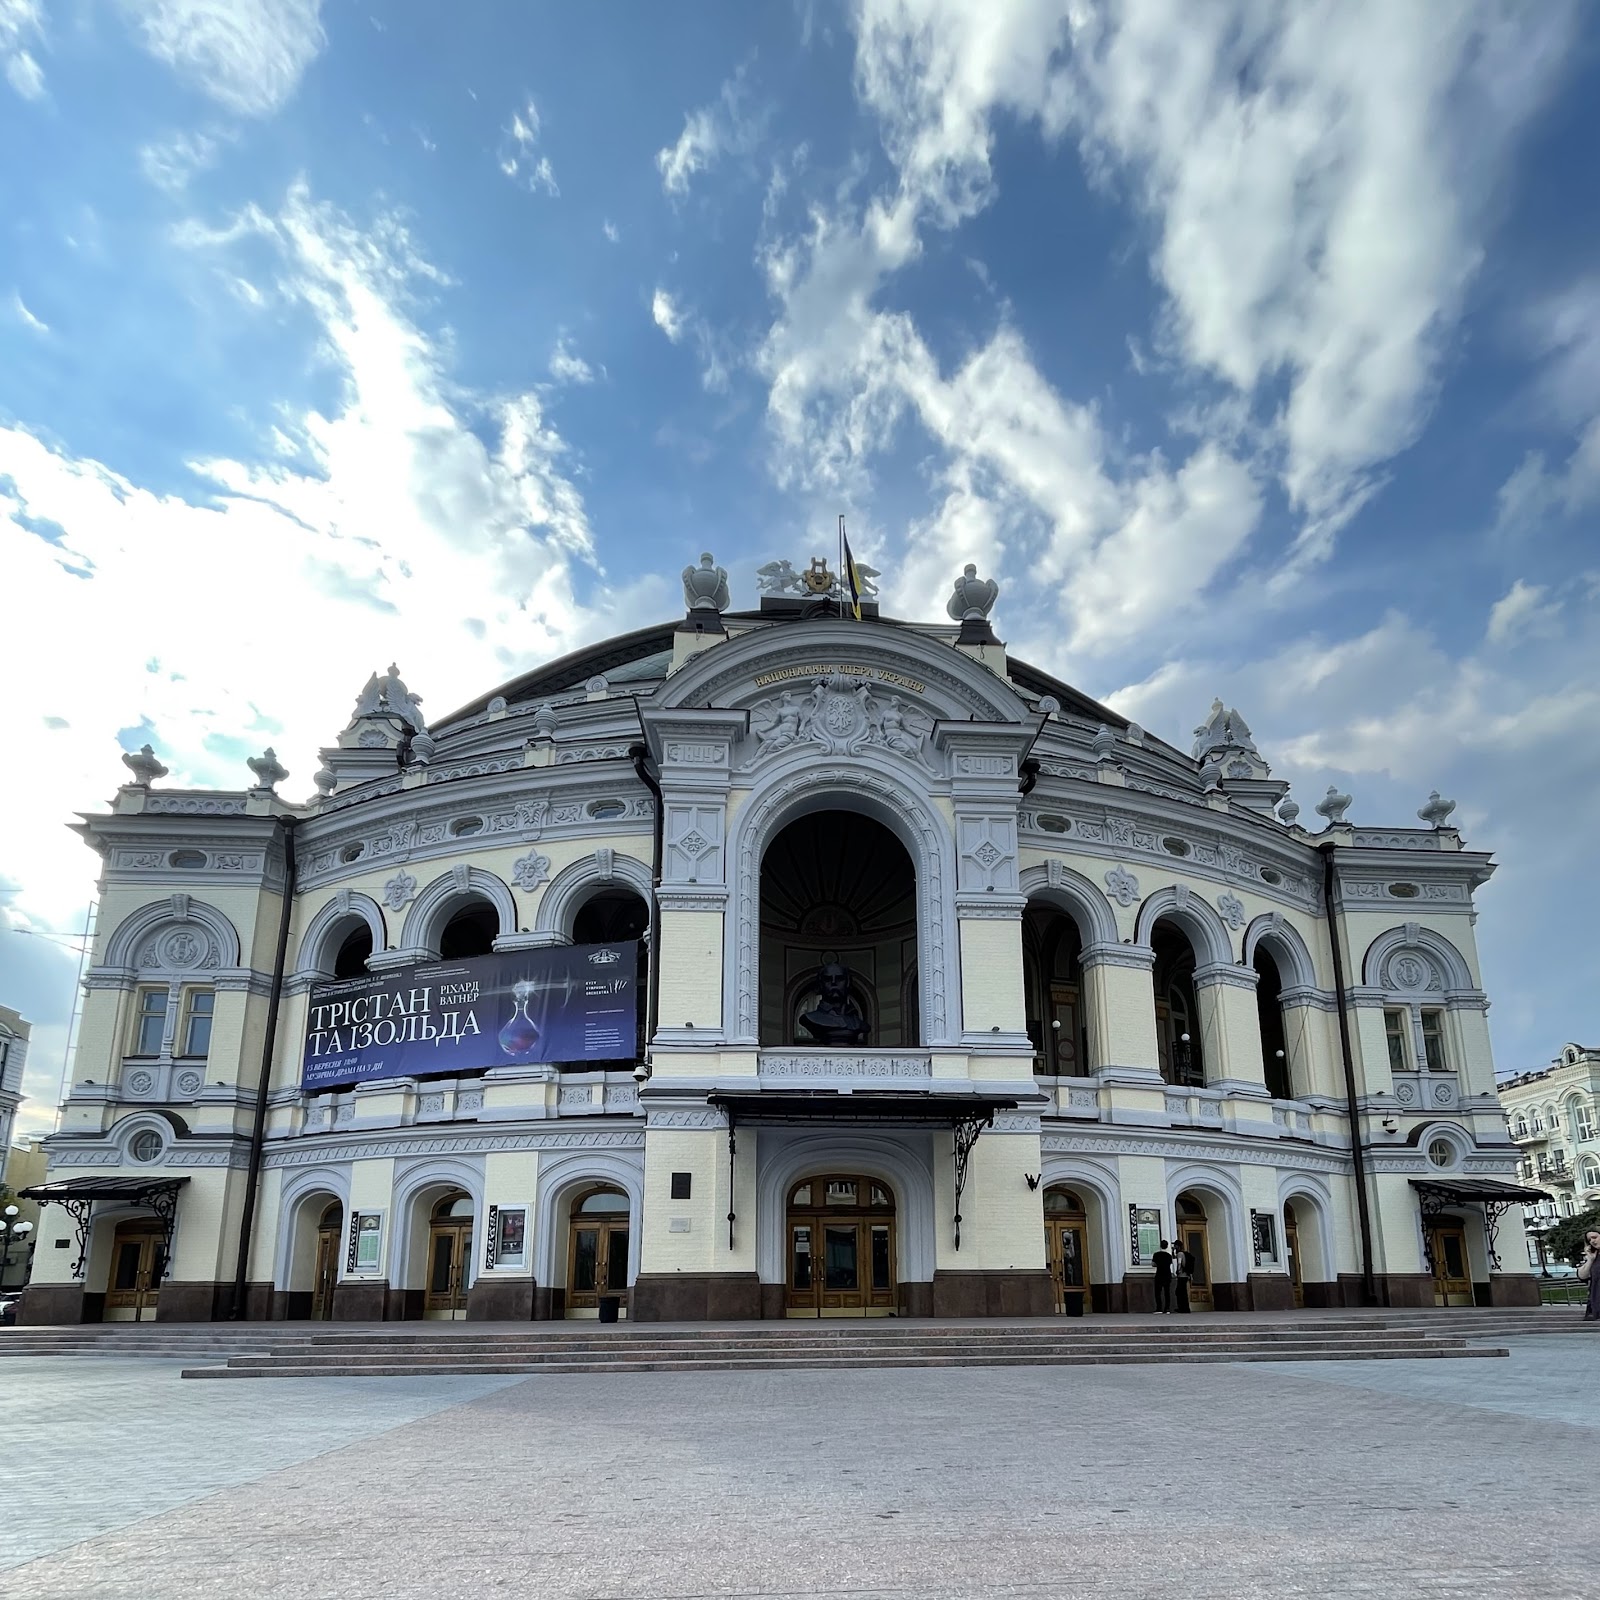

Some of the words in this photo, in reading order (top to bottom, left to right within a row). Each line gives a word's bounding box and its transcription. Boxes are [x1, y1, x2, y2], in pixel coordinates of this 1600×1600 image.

[755, 665, 834, 687] НАЦІОНАЛЬНА
[839, 664, 873, 677] ОПЕРА
[878, 670, 926, 693] УКРАЇНИ
[440, 981, 479, 995] РІХАРД
[440, 994, 479, 1006] ВАГНЕР
[311, 987, 432, 1030] ТРІСТАН
[309, 1029, 343, 1057] ТА
[349, 1010, 481, 1051] ІЗОЛЬДА
